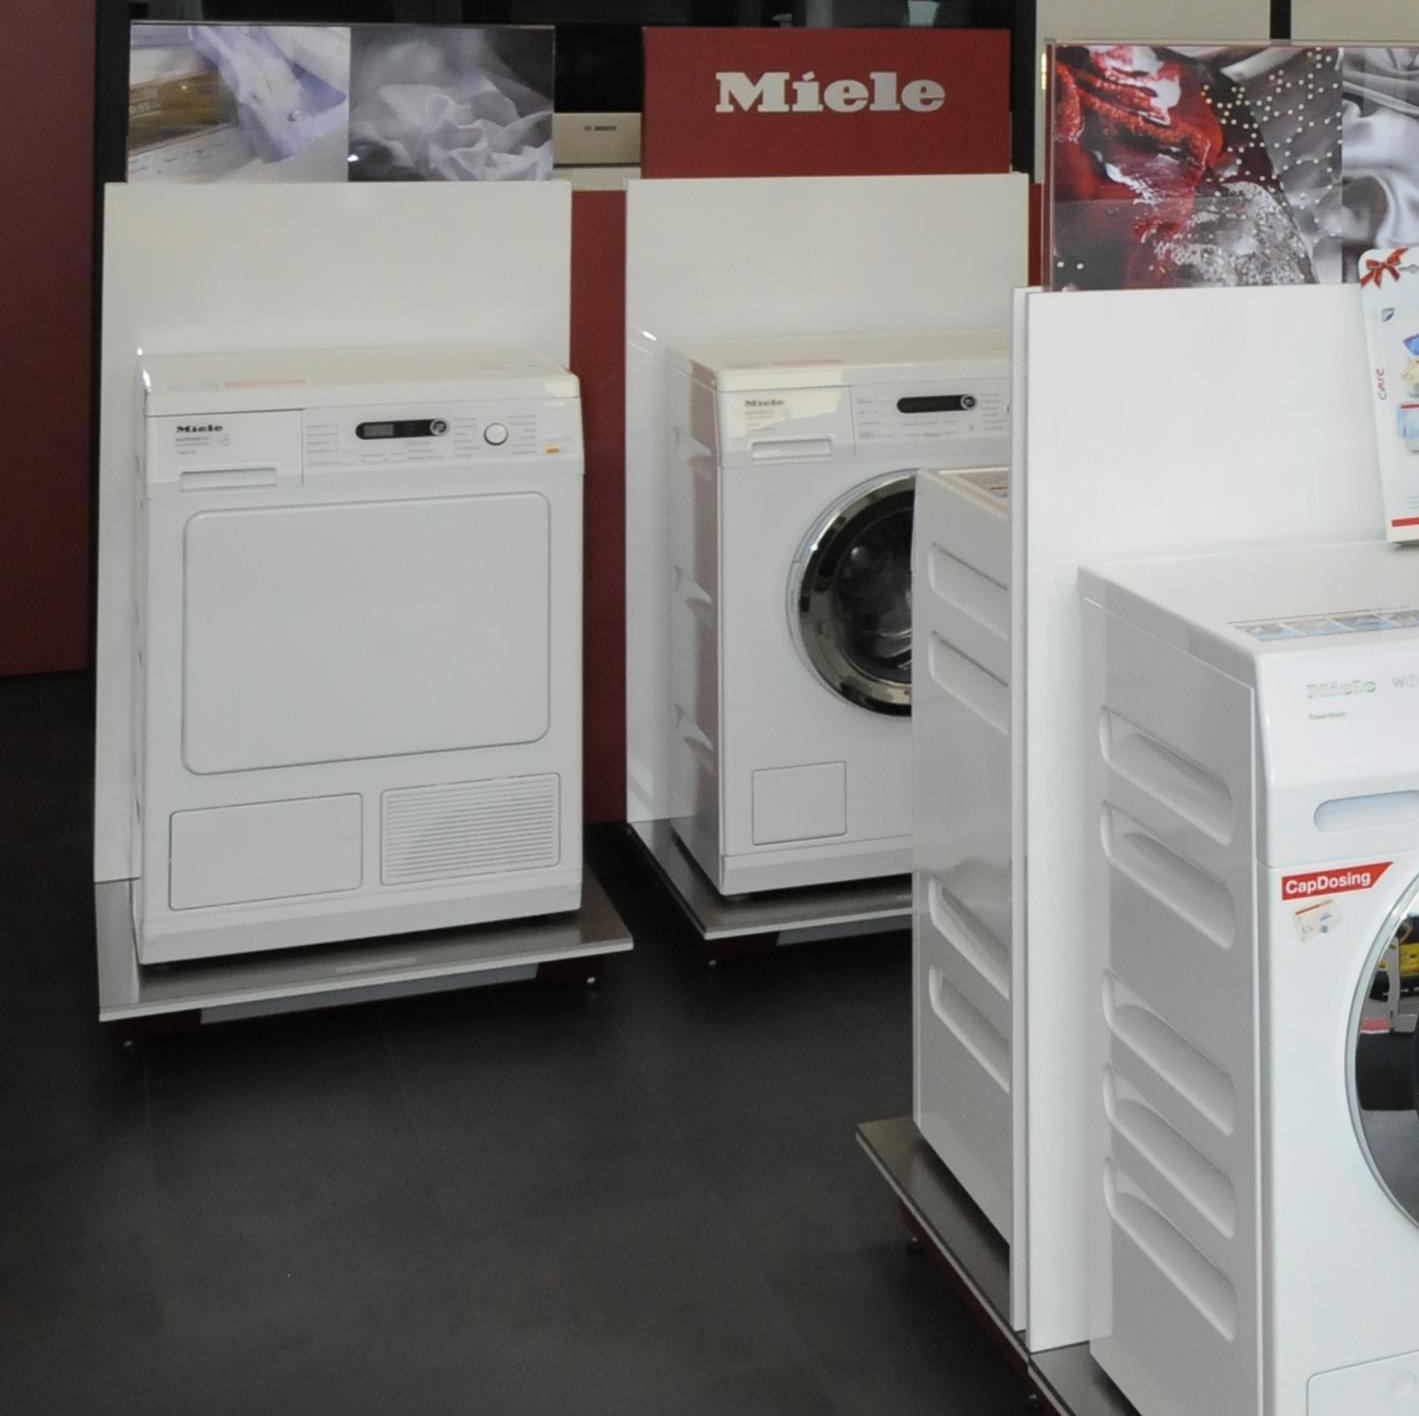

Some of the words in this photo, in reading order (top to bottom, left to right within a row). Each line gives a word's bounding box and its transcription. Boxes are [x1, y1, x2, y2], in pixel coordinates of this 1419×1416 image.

[715, 71, 946, 113] Miele
[176, 424, 223, 433] Miele
[1285, 872, 1371, 895] CapDosing
